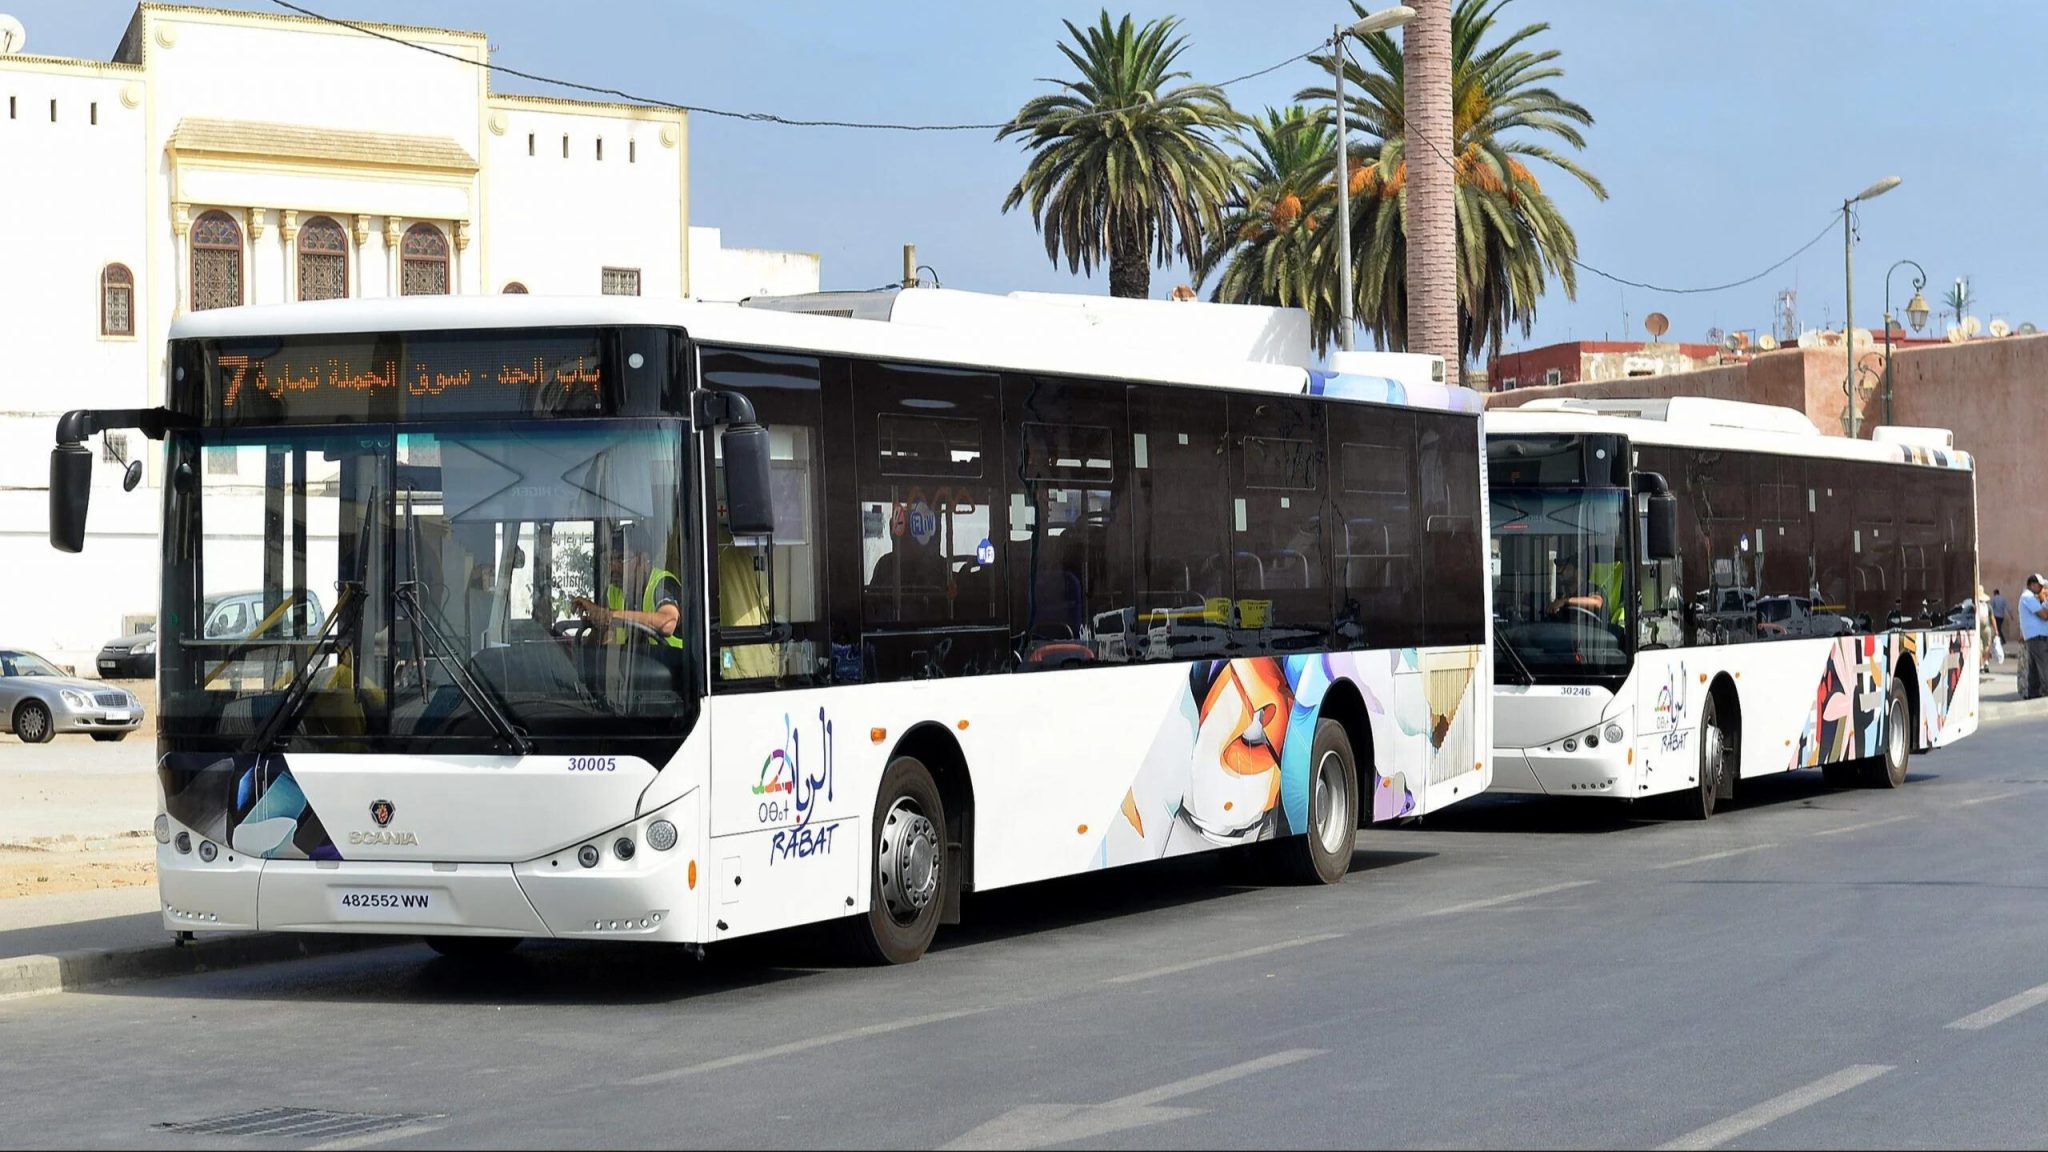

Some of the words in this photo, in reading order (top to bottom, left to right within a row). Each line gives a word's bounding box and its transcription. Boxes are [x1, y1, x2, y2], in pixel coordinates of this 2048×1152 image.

[218, 355, 248, 406] 7
[256, 360, 320, 398] تمارة
[329, 359, 397, 396] الجملة
[409, 363, 472, 395] سوق
[557, 356, 600, 391] باب
[1560, 686, 1591, 697] 30246
[1661, 732, 1689, 755] RABAT
[568, 757, 616, 771] 30005
[349, 831, 420, 846] SCANIA
[769, 823, 840, 866] RABAT
[342, 894, 399, 908] 482552
[401, 894, 429, 908] WW
